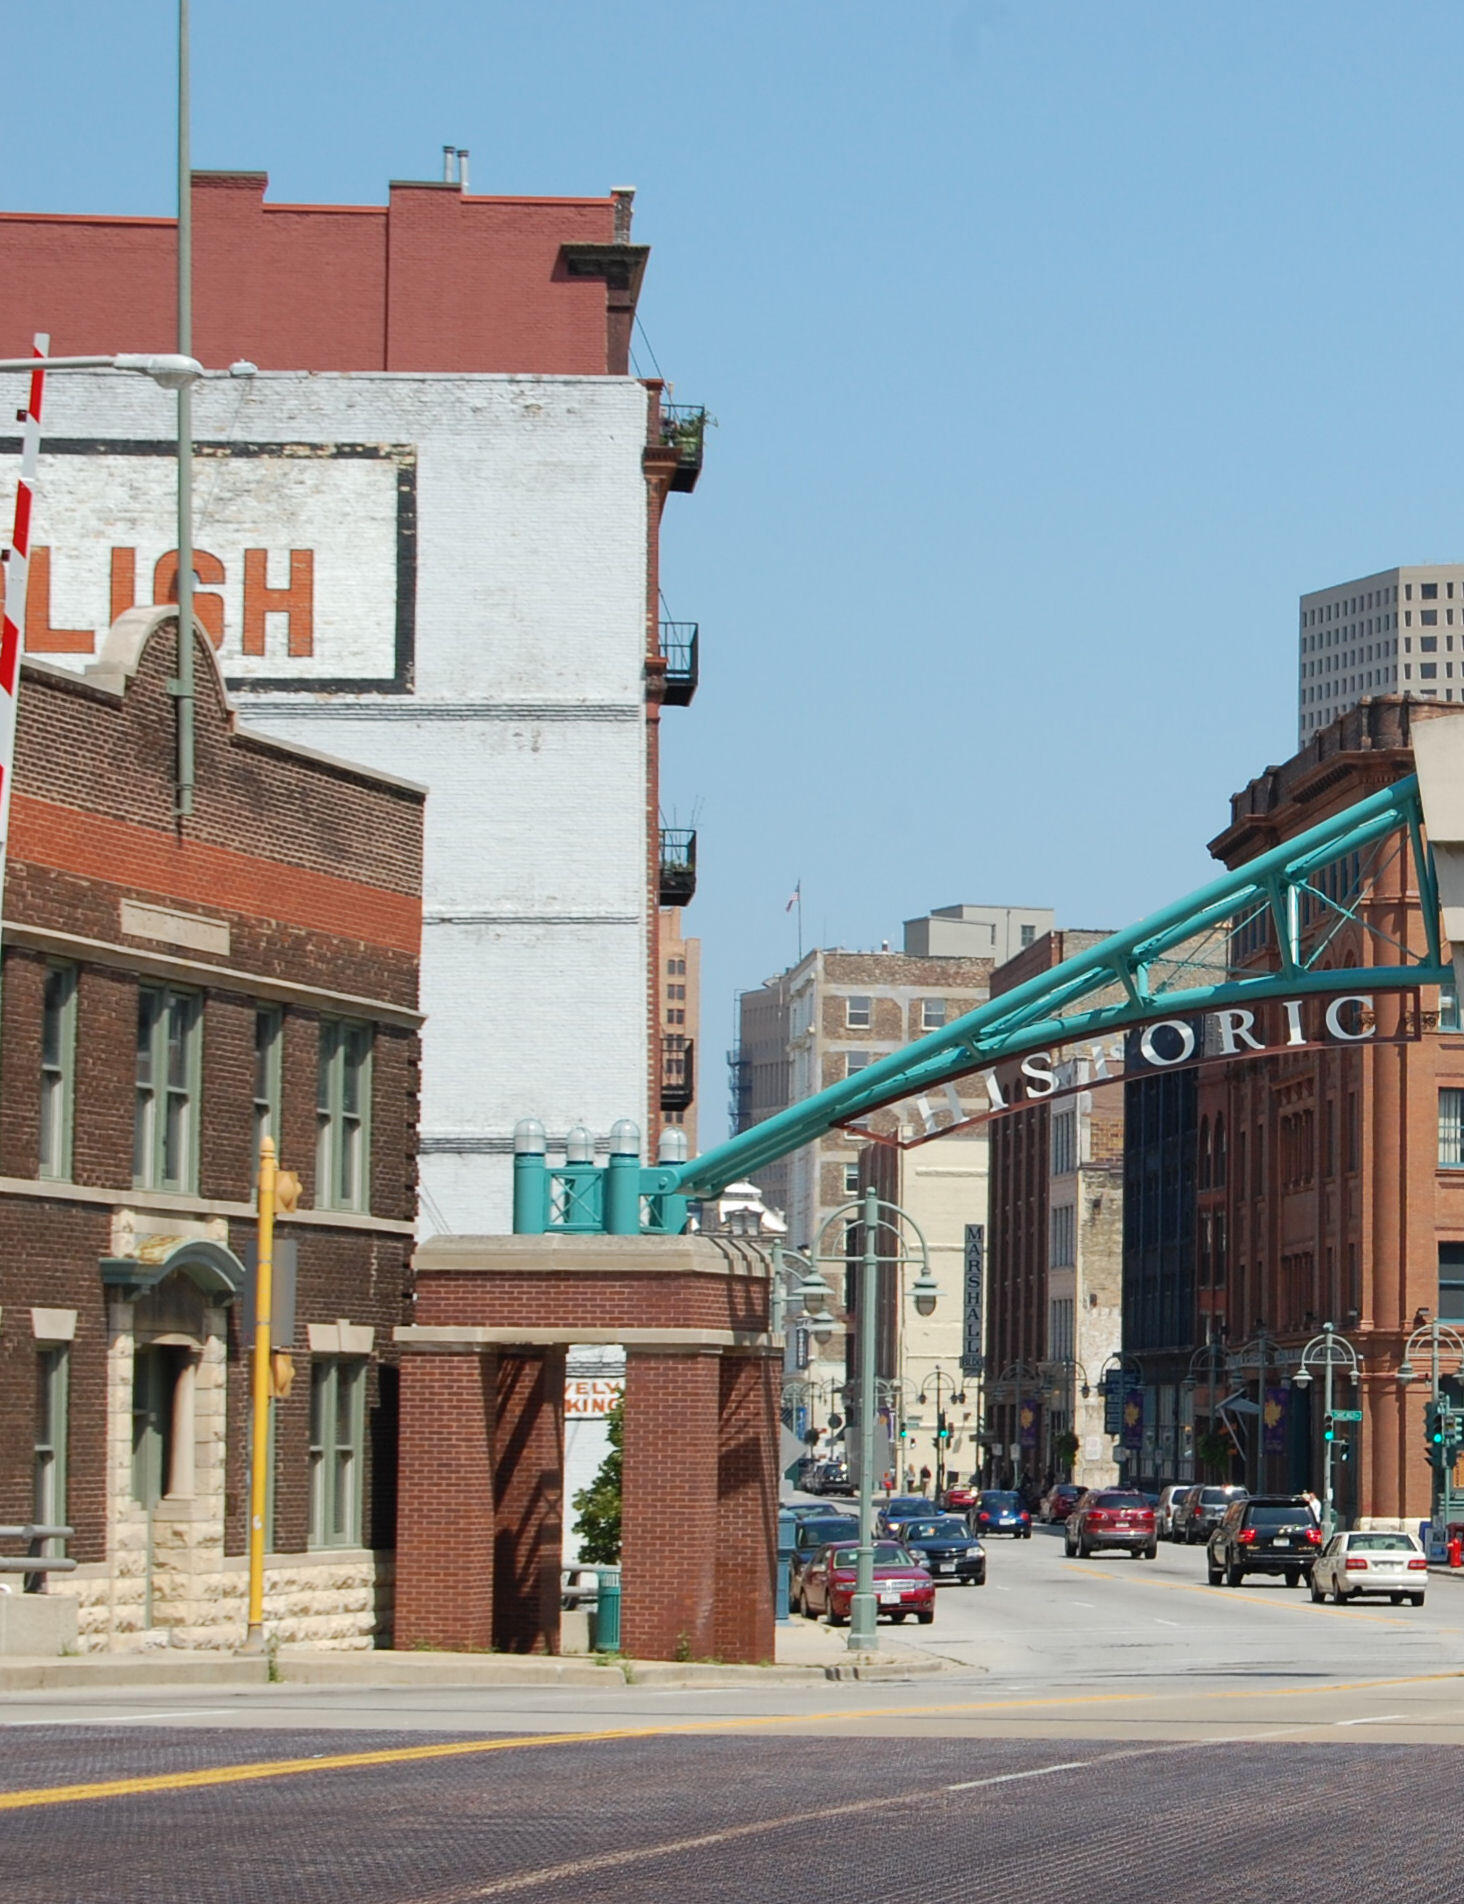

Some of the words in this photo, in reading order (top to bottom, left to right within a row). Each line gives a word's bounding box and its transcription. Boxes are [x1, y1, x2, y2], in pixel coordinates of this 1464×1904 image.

[0, 545, 315, 657] LISH
[914, 995, 1377, 1135] HISTORIC
[966, 1227, 982, 1354] MARSHALL
